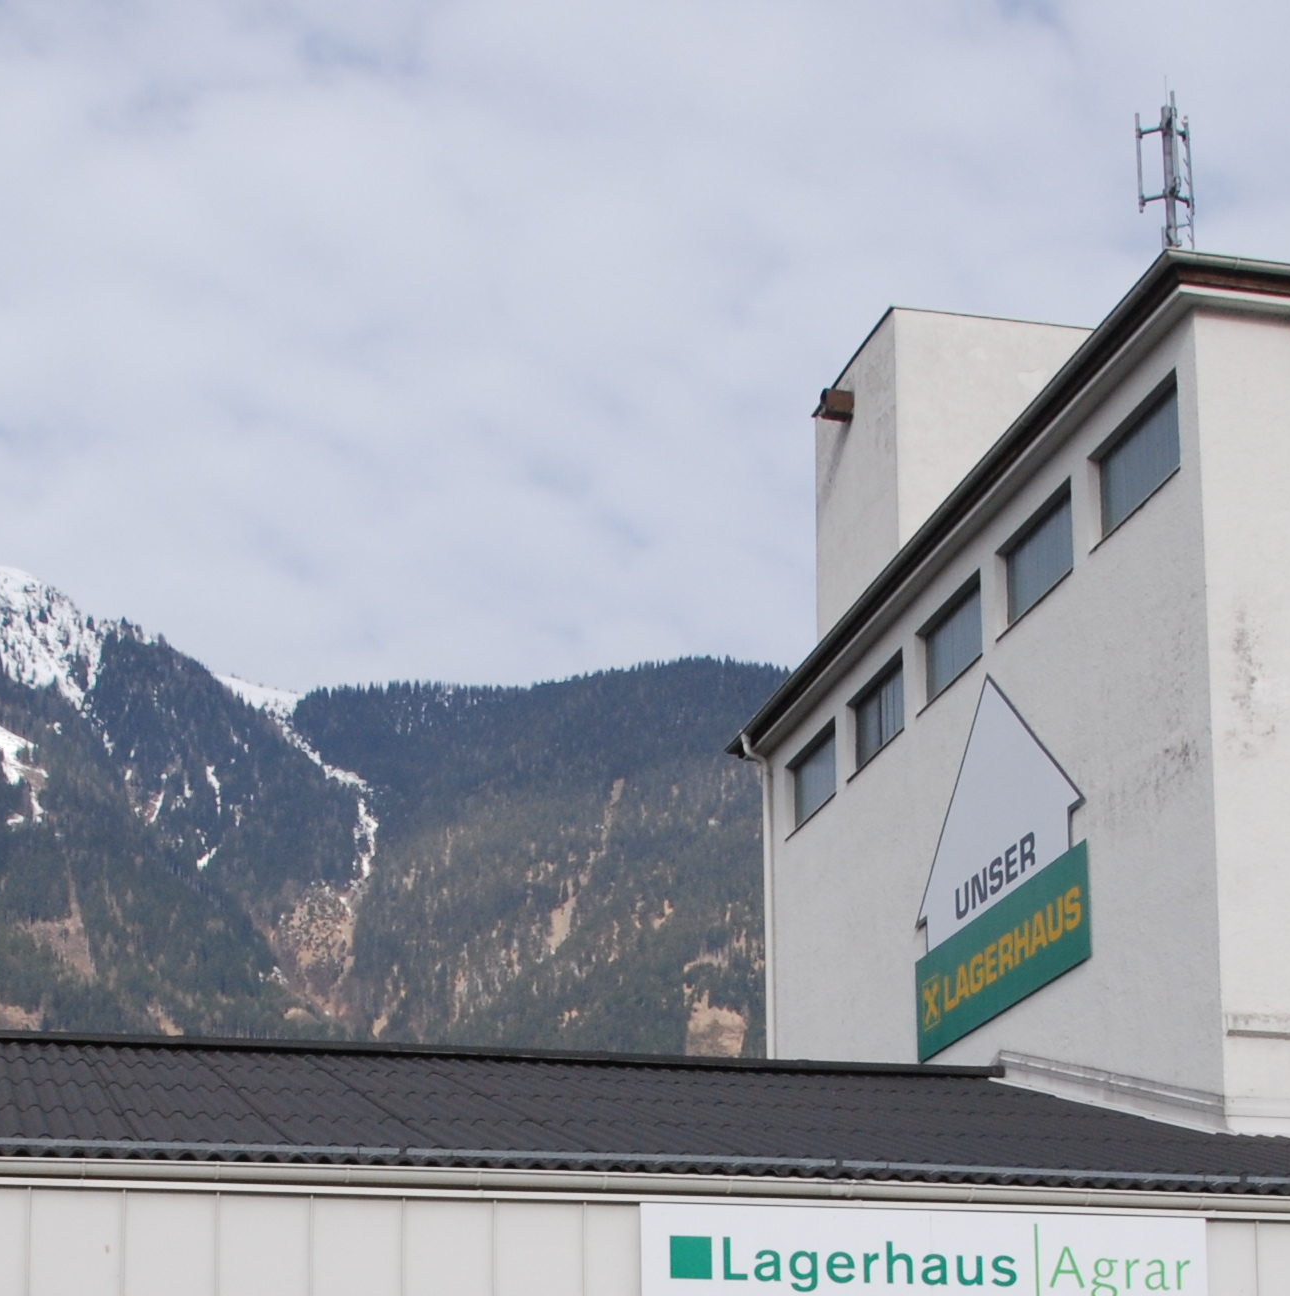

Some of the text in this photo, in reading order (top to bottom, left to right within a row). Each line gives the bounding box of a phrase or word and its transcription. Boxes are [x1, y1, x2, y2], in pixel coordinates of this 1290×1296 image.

[955, 831, 1036, 920] UNSER
[944, 885, 1082, 1012] LAGERHAUS
[722, 1236, 1018, 1293] Lagerhaus
